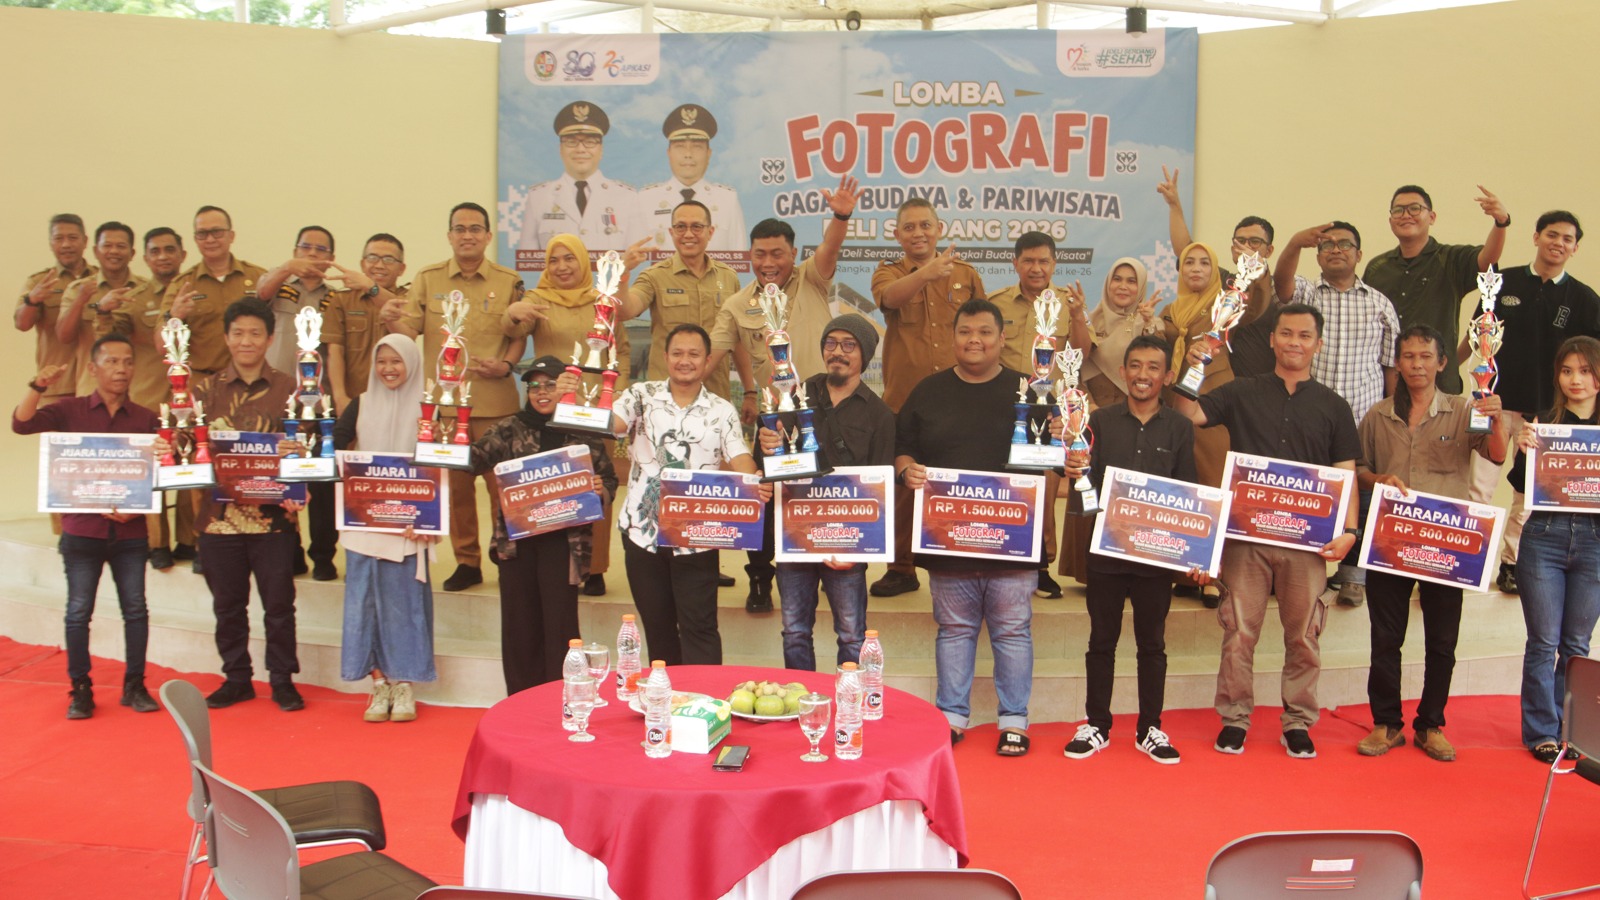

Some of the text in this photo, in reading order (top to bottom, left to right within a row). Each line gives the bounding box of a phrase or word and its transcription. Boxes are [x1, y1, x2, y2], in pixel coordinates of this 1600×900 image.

[893, 82, 1004, 106] LOMBA
[787, 112, 1109, 180] FOTOGRAFI
[775, 186, 1121, 219] CAGA BUDAYA & PARIWISATA
[987, 266, 1006, 275] dan
[60, 448, 142, 458] JUARA FAVORIT
[230, 442, 273, 454] JUARA
[1549, 442, 1588, 452] JUARA
[221, 458, 240, 469] RP.
[245, 459, 279, 470] 1.500.
[1548, 458, 1570, 469] RP.
[365, 466, 417, 479] JUARA II
[518, 461, 571, 483] JUARA II
[353, 481, 430, 495] RP. 2.000.000
[510, 489, 530, 503] RP.
[532, 475, 588, 498] 2.000.000
[1247, 470, 1325, 493] HARAPAN II
[1567, 481, 1600, 494] FOTOG
[685, 485, 739, 498] JUARA I
[807, 487, 858, 498] JUARA I
[947, 485, 1010, 500] JUARA III
[1247, 488, 1321, 510] RP. 750.000
[1128, 487, 1203, 512] HARAPAN I
[669, 502, 755, 516] RP. 2.500.000
[793, 504, 874, 516] RP. 2.500.000
[935, 501, 1022, 519] RP. 1.500.000
[1393, 503, 1478, 530] HARAPAN III
[1120, 503, 1206, 531] RP. 1.000.000
[1255, 512, 1308, 530] FOTOGRAFI
[686, 525, 738, 539] FOTOGRAFI
[811, 527, 859, 539] FOTOGRAFI
[953, 525, 1005, 540] FOTOGRAFI
[1393, 521, 1471, 547] RP. 500.000
[1134, 530, 1187, 550] FOTOGRAFI
[1402, 546, 1456, 567] FOTOGRAFI
[649, 731, 663, 741] Cleo
